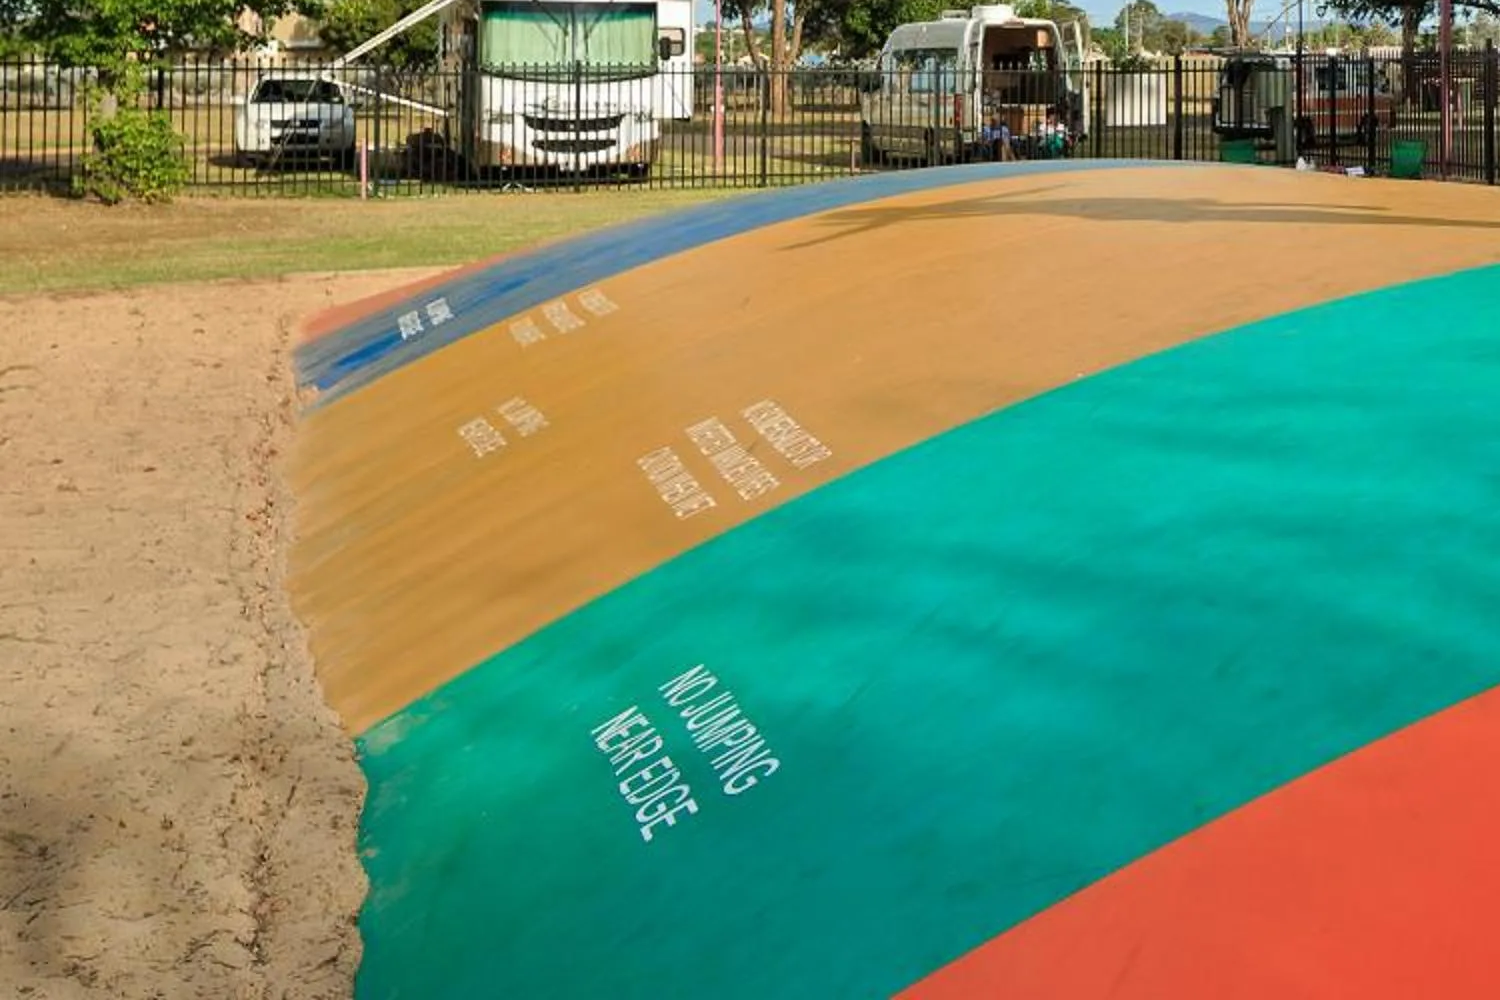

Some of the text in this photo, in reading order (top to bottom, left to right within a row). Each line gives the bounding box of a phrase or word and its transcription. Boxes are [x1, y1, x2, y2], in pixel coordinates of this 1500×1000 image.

[590, 704, 699, 843] NEAR EDGE
[657, 663, 781, 796] NO JUMPING
